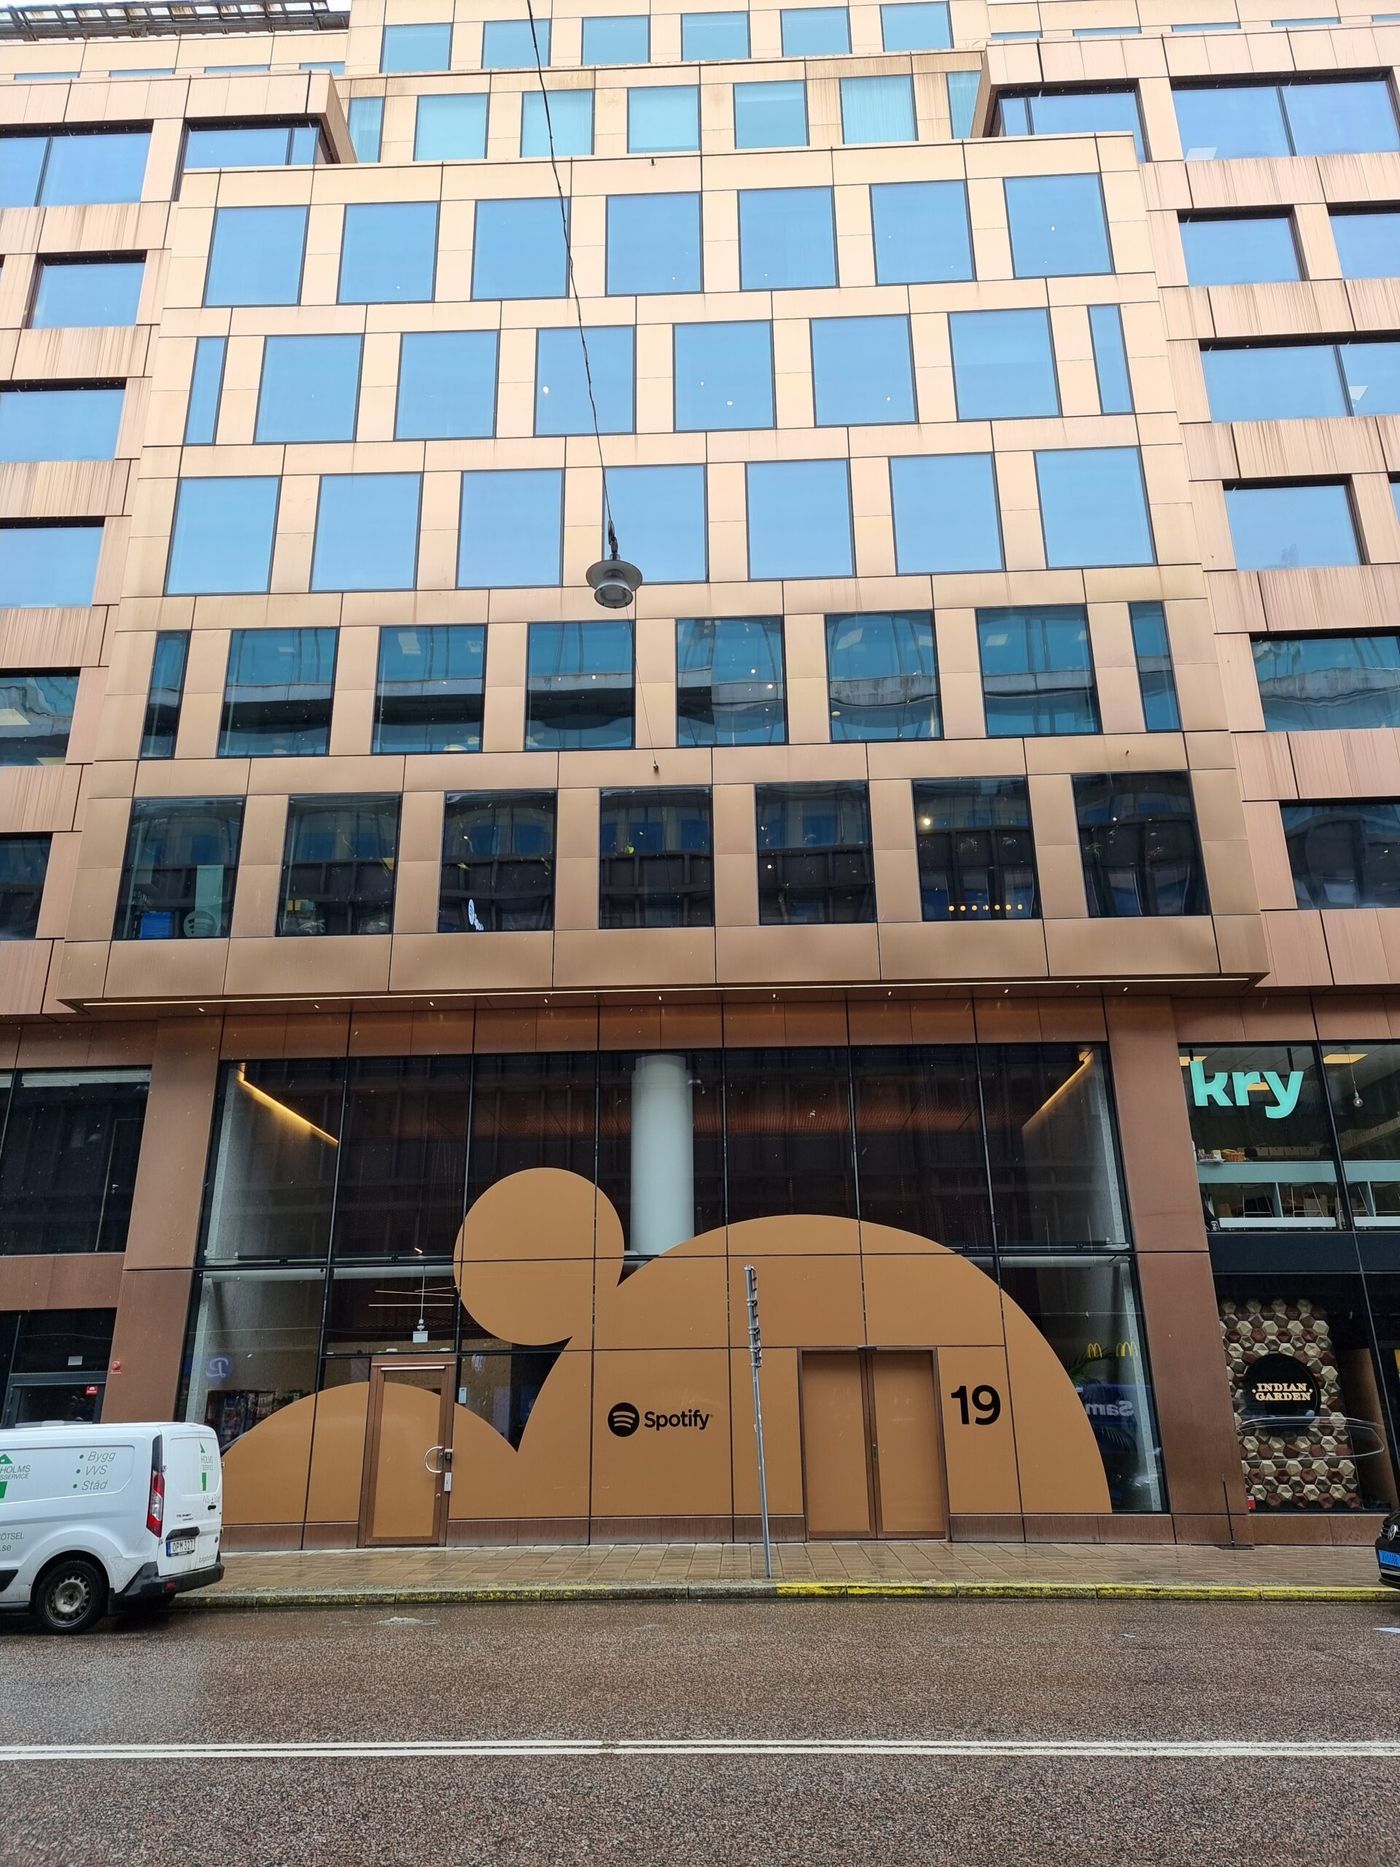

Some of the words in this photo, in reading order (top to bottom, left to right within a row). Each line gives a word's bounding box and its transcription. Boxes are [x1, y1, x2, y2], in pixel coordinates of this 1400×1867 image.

[1189, 1060, 1305, 1119] kry
[1256, 1382, 1307, 1392] INDIAN
[1255, 1392, 1311, 1401] GARDEN
[951, 1385, 1001, 1425] 19
[644, 1409, 710, 1431] Spotify
[87, 1451, 116, 1463] Bygg
[85, 1465, 108, 1475] VVS
